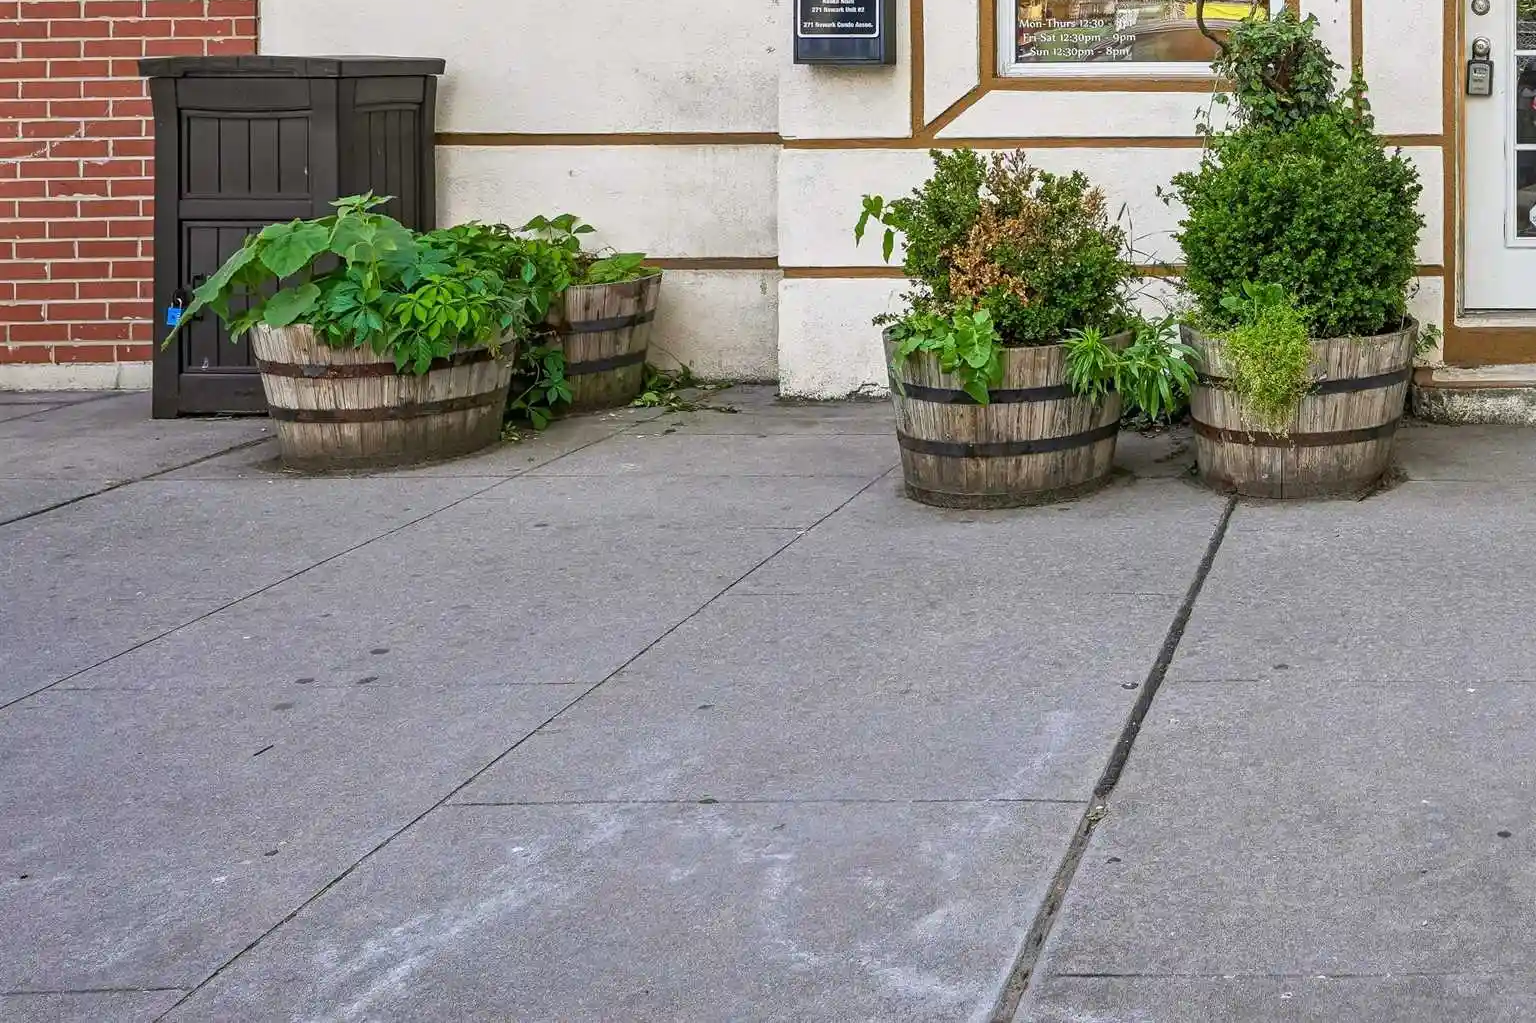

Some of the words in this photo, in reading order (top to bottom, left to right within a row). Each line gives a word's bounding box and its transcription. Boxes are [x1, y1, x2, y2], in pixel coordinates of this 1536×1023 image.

[1018, 18, 1077, 28] Mon-Thurs
[1079, 18, 1105, 29] 12:30
[1023, 33, 1056, 43] Fri-Sat
[1060, 33, 1101, 44] 12:30pm
[1112, 33, 1136, 45] 9pm
[1030, 46, 1049, 56] Sun
[1053, 47, 1094, 58] 12:30pm
[1105, 46, 1130, 59] 8pm
